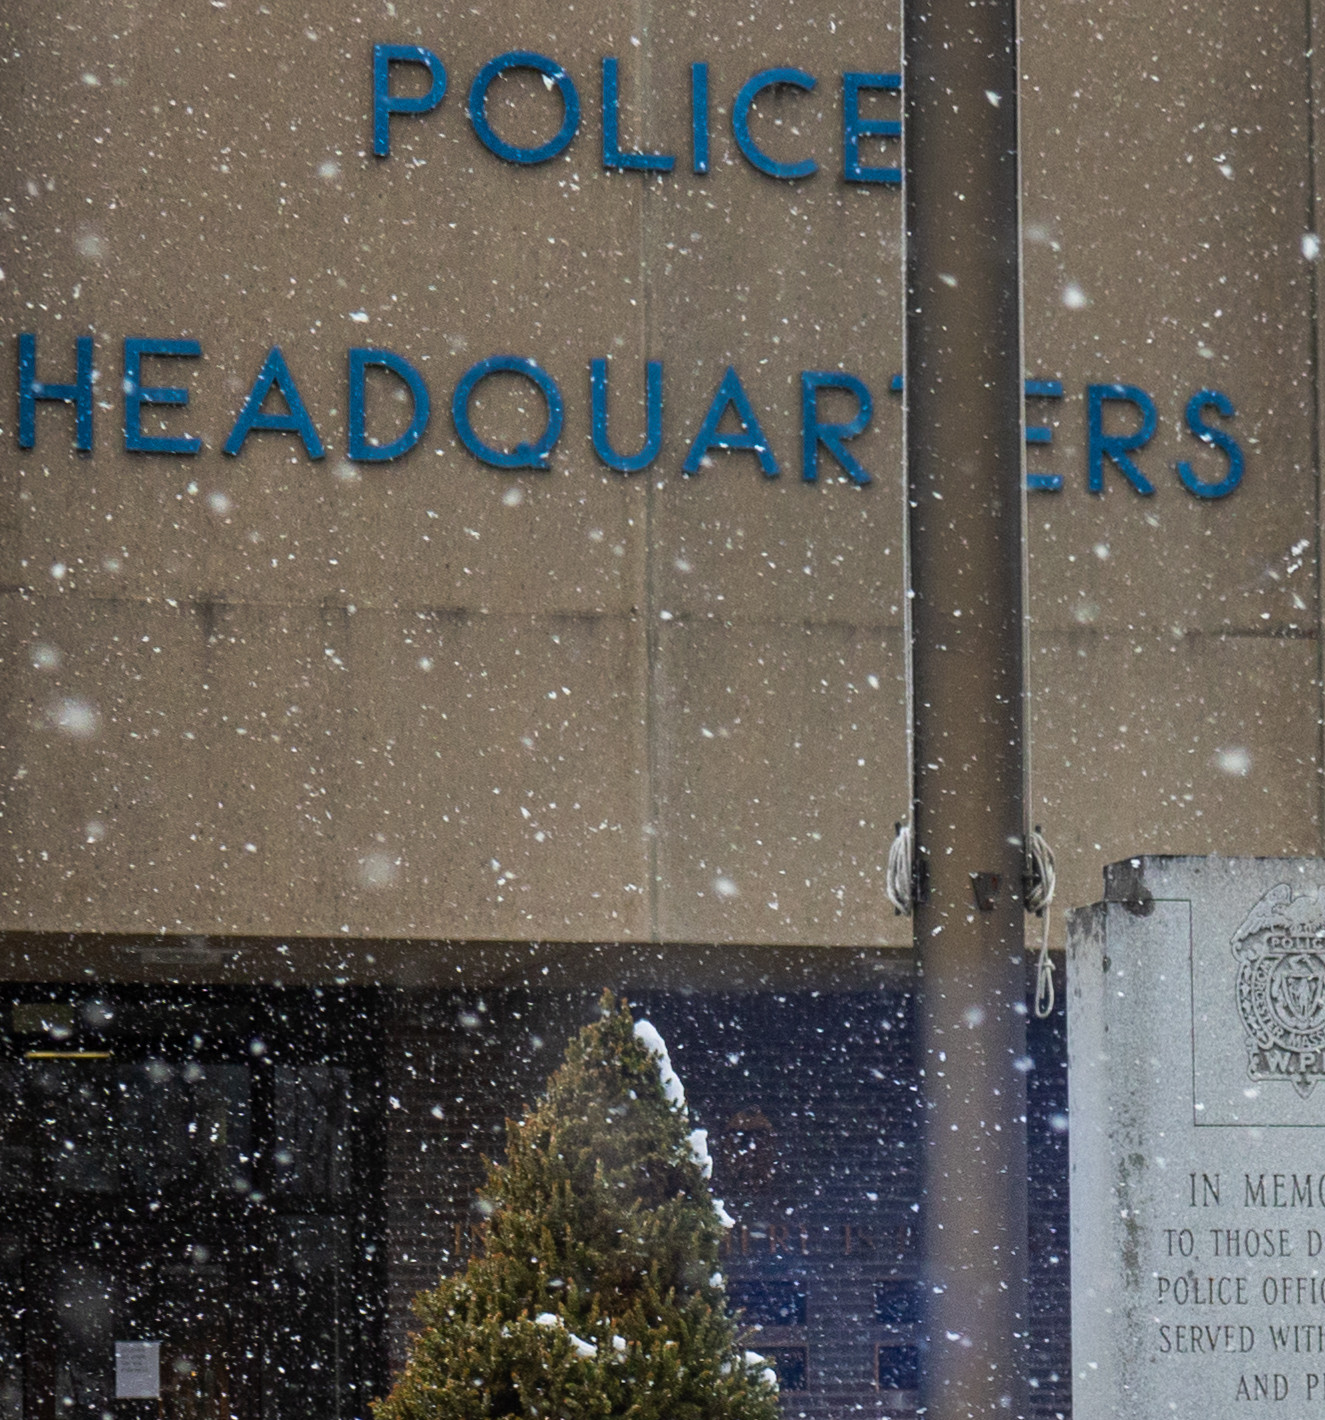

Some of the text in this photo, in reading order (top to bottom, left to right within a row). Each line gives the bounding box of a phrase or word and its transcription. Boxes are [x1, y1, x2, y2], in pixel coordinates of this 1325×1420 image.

[373, 44, 901, 184] POLICE
[19, 332, 1246, 499] HEADQUARERS
[1189, 1172, 1221, 1208] IN
[1163, 1228, 1195, 1257] TO
[1210, 1228, 1292, 1257] THOSE
[1157, 1276, 1249, 1305] POLICE
[1159, 1325, 1255, 1354] SERVED
[1235, 1373, 1289, 1402] AND
